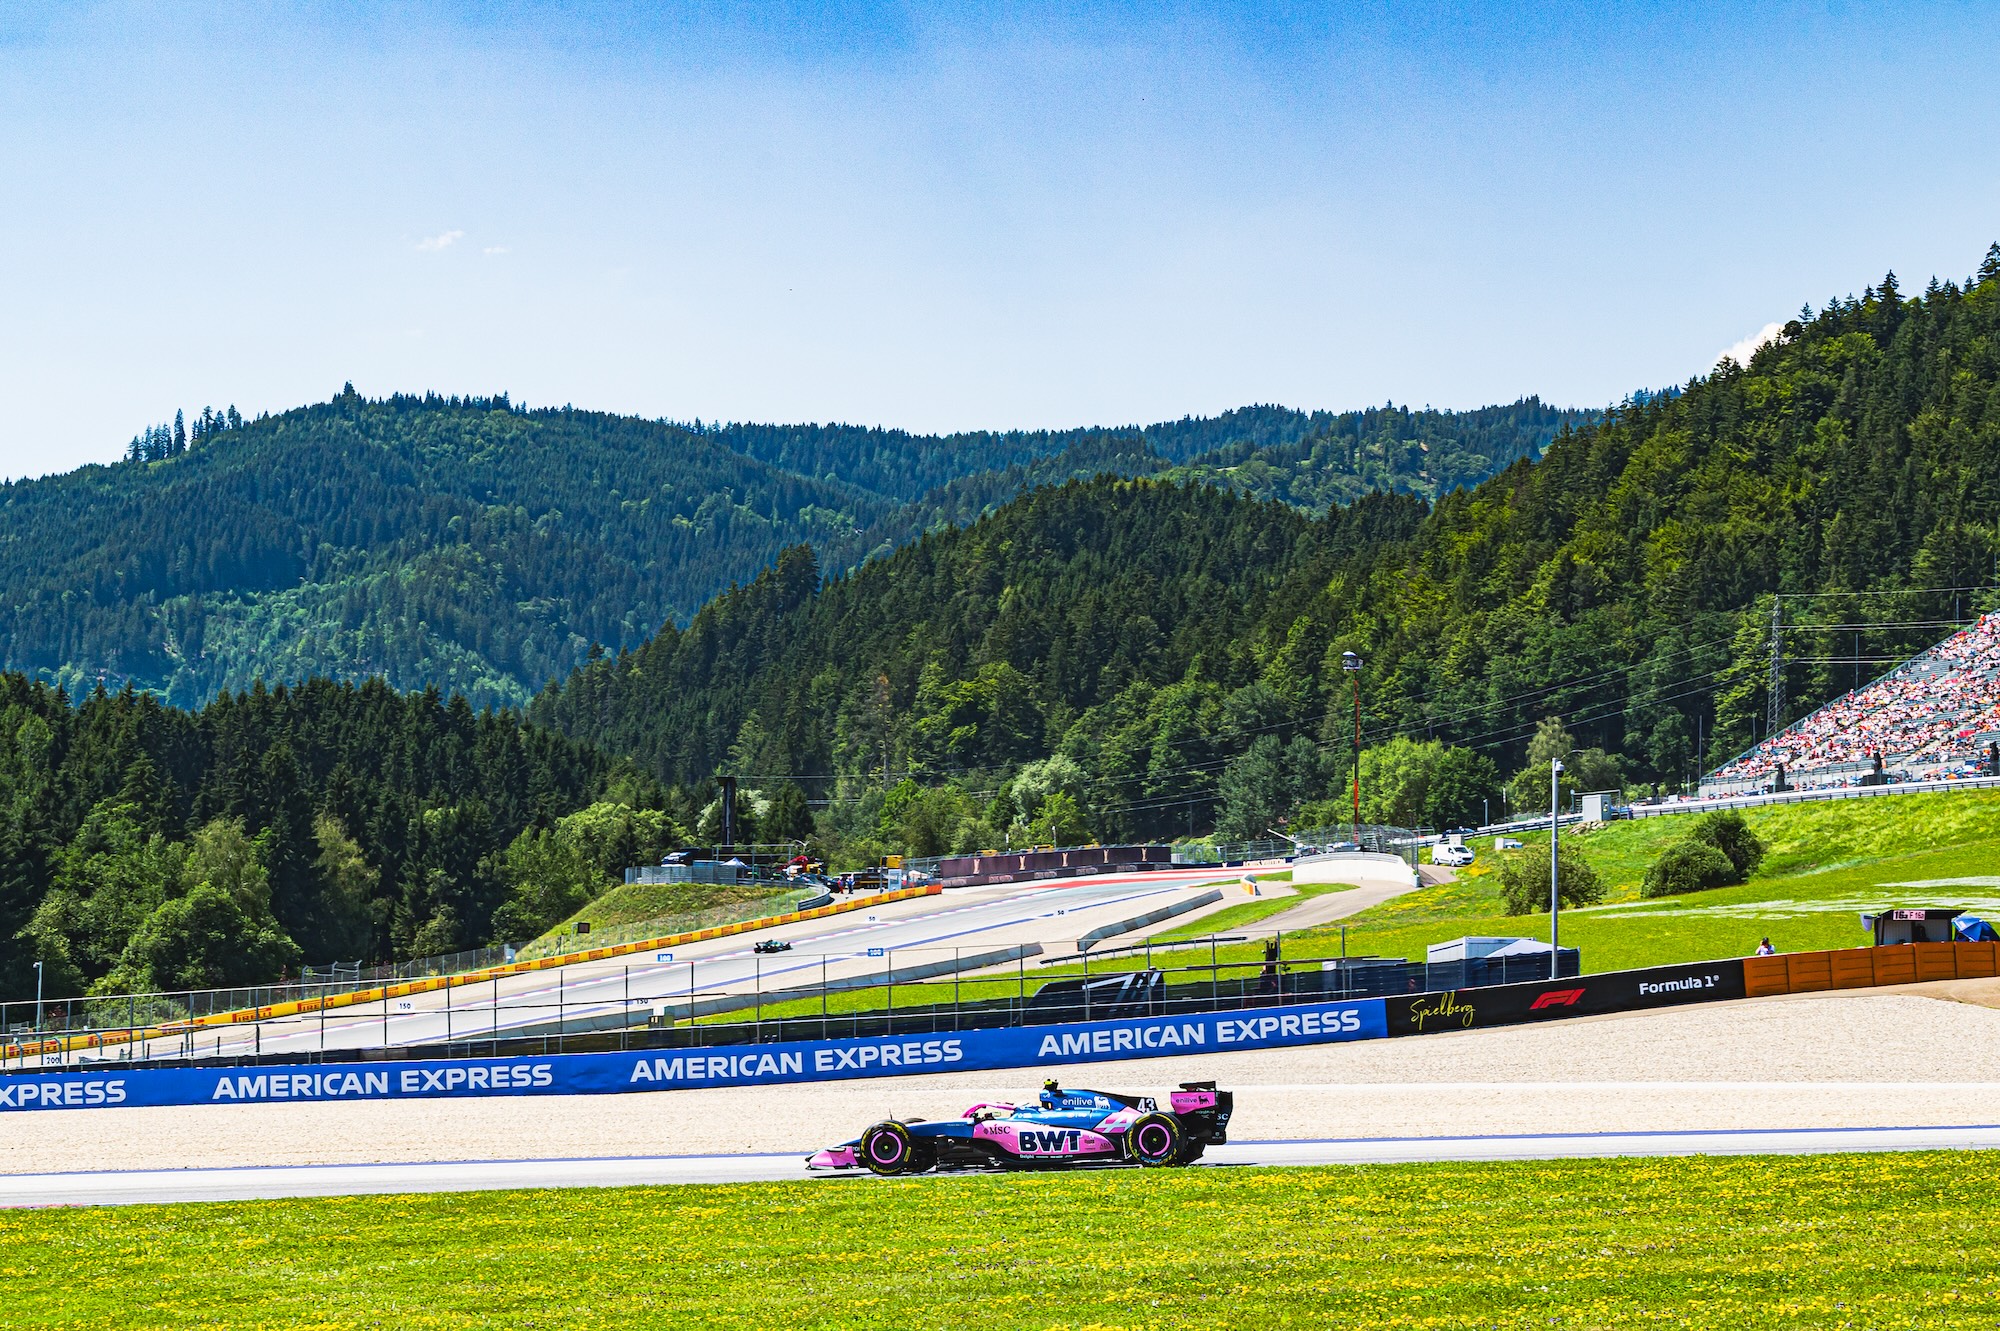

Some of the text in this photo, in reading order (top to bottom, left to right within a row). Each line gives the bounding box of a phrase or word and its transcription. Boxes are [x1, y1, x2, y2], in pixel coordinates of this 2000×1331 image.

[1639, 976, 1702, 995] Formula
[297, 998, 334, 1012] PIRELI
[1410, 992, 1476, 1030] Spielberg
[232, 1008, 272, 1023] PIRELI
[1038, 1010, 1361, 1057] AMERICAN EXPRESS
[8, 1040, 57, 1056] PIRELI
[630, 1040, 963, 1083] AMERICAN EXPRESS
[212, 1064, 553, 1099] AMERICAN EXPRESS
[0, 1081, 127, 1107] XPRESS
[1062, 1097, 1093, 1107] enilive
[1137, 1098, 1155, 1112] 43
[989, 1124, 1011, 1135] MSC
[1018, 1130, 1082, 1153] BWT
